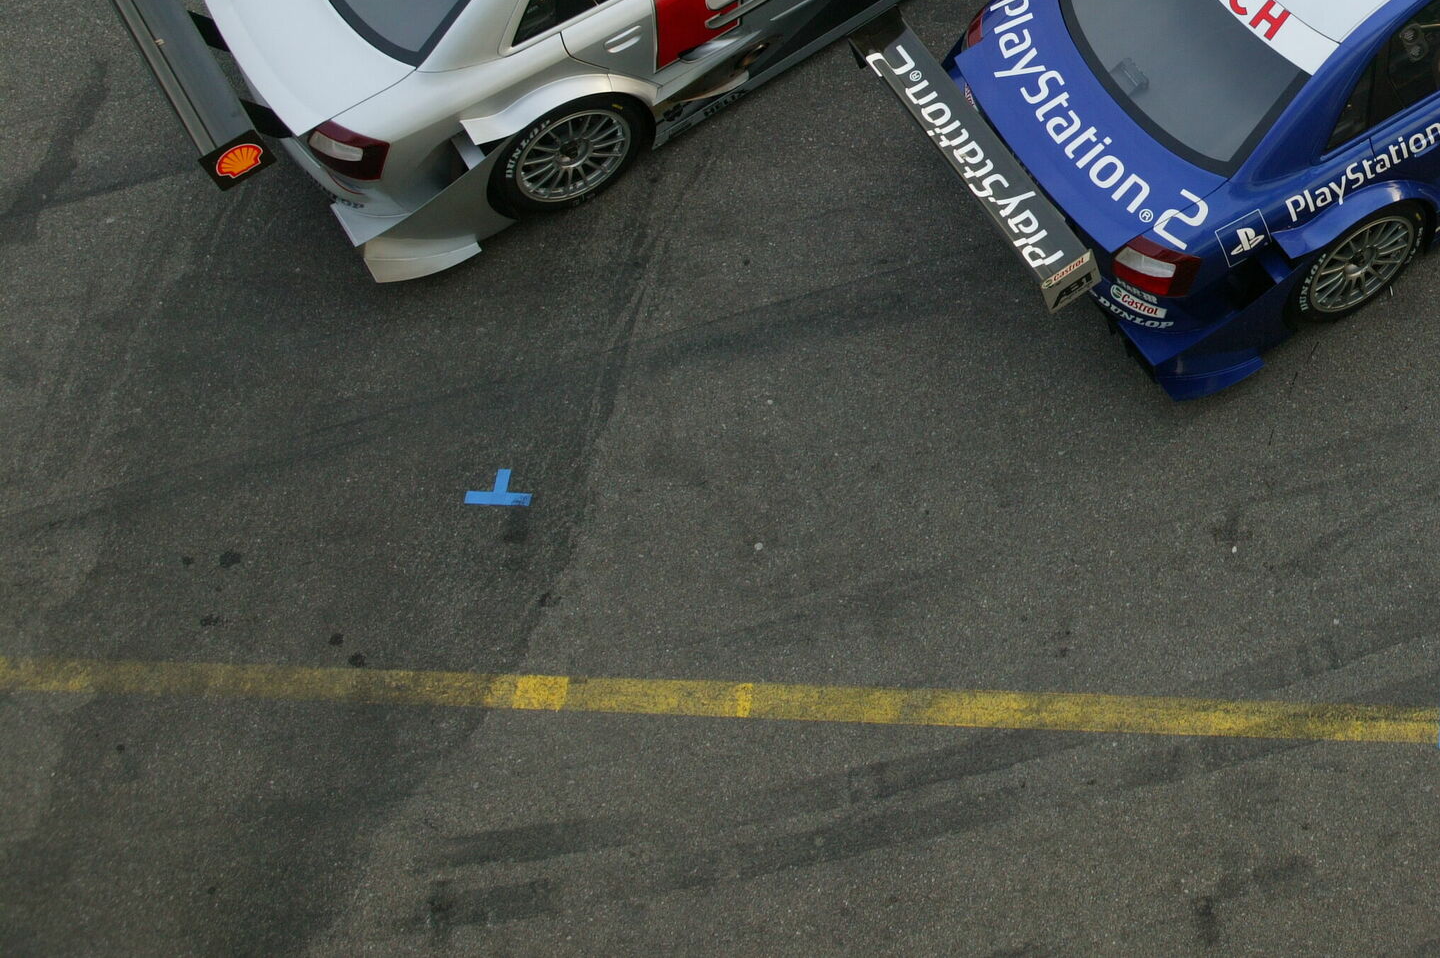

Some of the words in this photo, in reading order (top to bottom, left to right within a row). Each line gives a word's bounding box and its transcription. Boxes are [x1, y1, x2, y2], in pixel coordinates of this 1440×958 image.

[1053, 257, 1085, 282] Castrol
[1098, 295, 1175, 329] DUNLOP
[1121, 293, 1159, 316] Castrol
